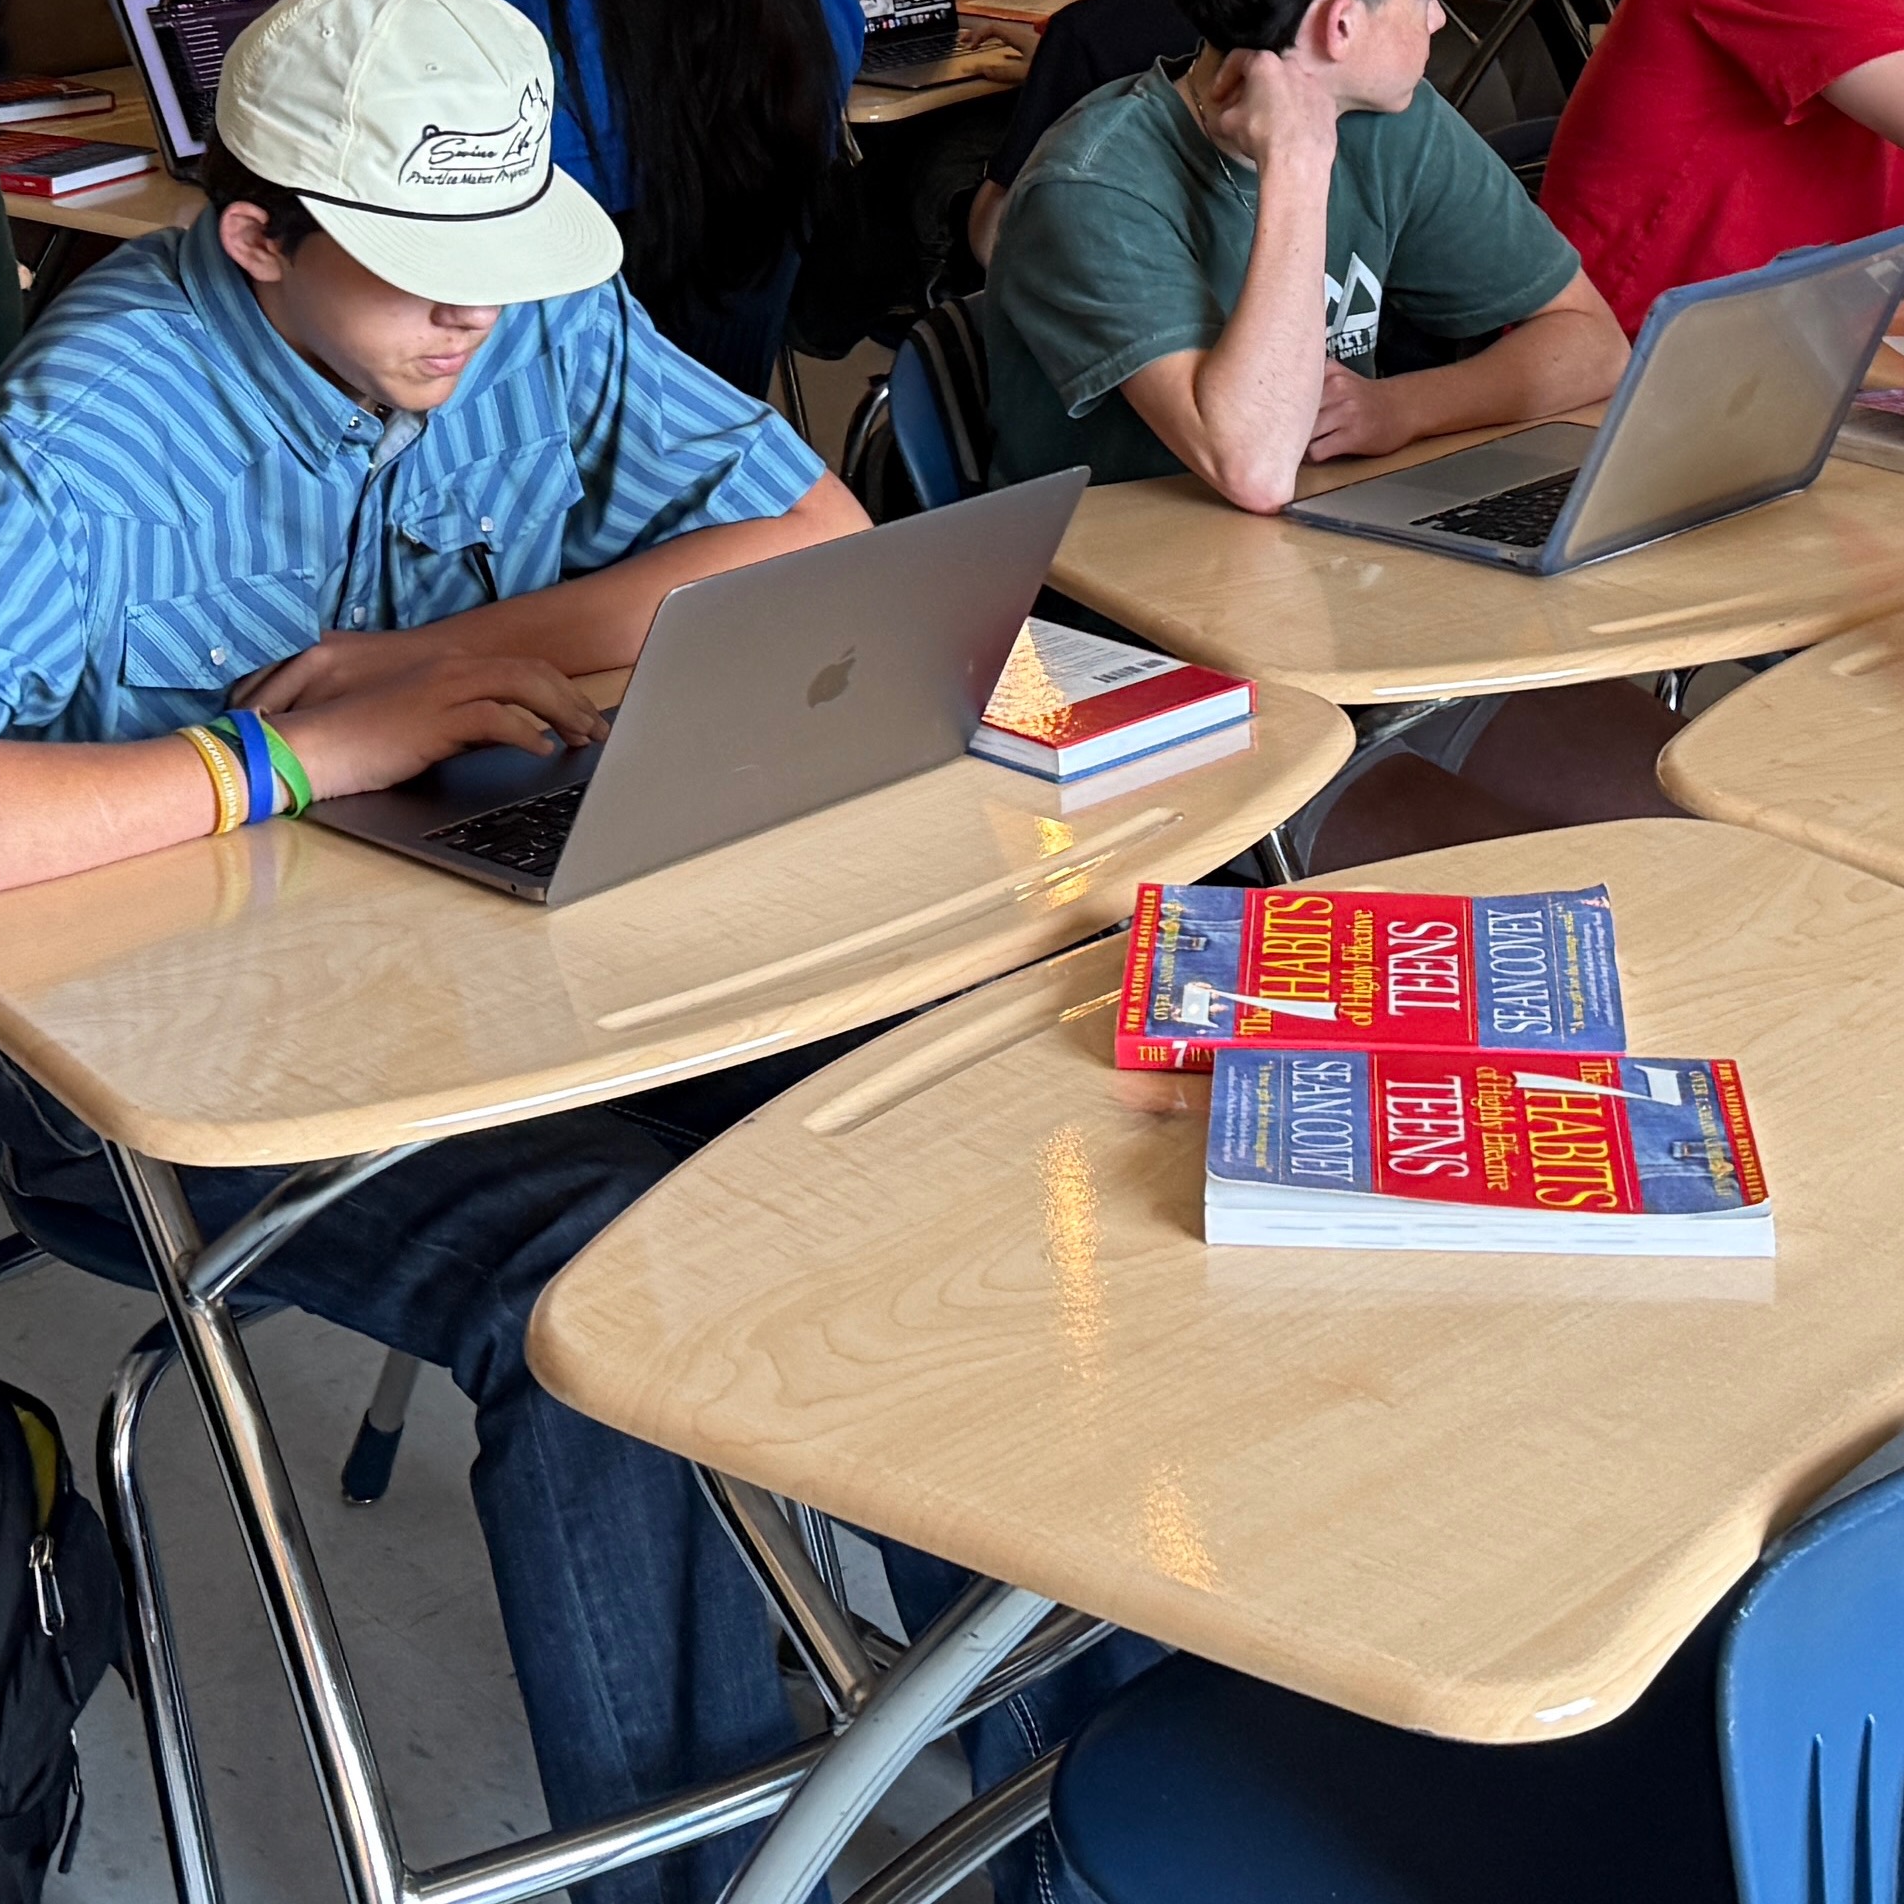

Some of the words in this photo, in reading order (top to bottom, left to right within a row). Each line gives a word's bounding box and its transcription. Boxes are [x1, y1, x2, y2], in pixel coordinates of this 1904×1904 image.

[1138, 889, 1157, 949] BESTSELLER
[1259, 895, 1334, 1001] HABITS
[1487, 908, 1548, 976] COVEY
[1130, 952, 1150, 1005] NATIONAL
[1387, 920, 1461, 1017] TEENS
[1124, 1009, 1144, 1031] THE
[1181, 982, 1342, 1028] 7
[1492, 976, 1553, 1035] SEAN
[1137, 1045, 1168, 1063] THE
[1171, 1040, 1189, 1069] 7
[1292, 1059, 1353, 1117] SEAN
[1511, 1064, 1683, 1106] 7
[1723, 1084, 1746, 1135] NATIONAL
[1290, 1117, 1354, 1183] COVEY
[1385, 1074, 1470, 1178] TEENS
[1523, 1088, 1619, 1209] HABITS
